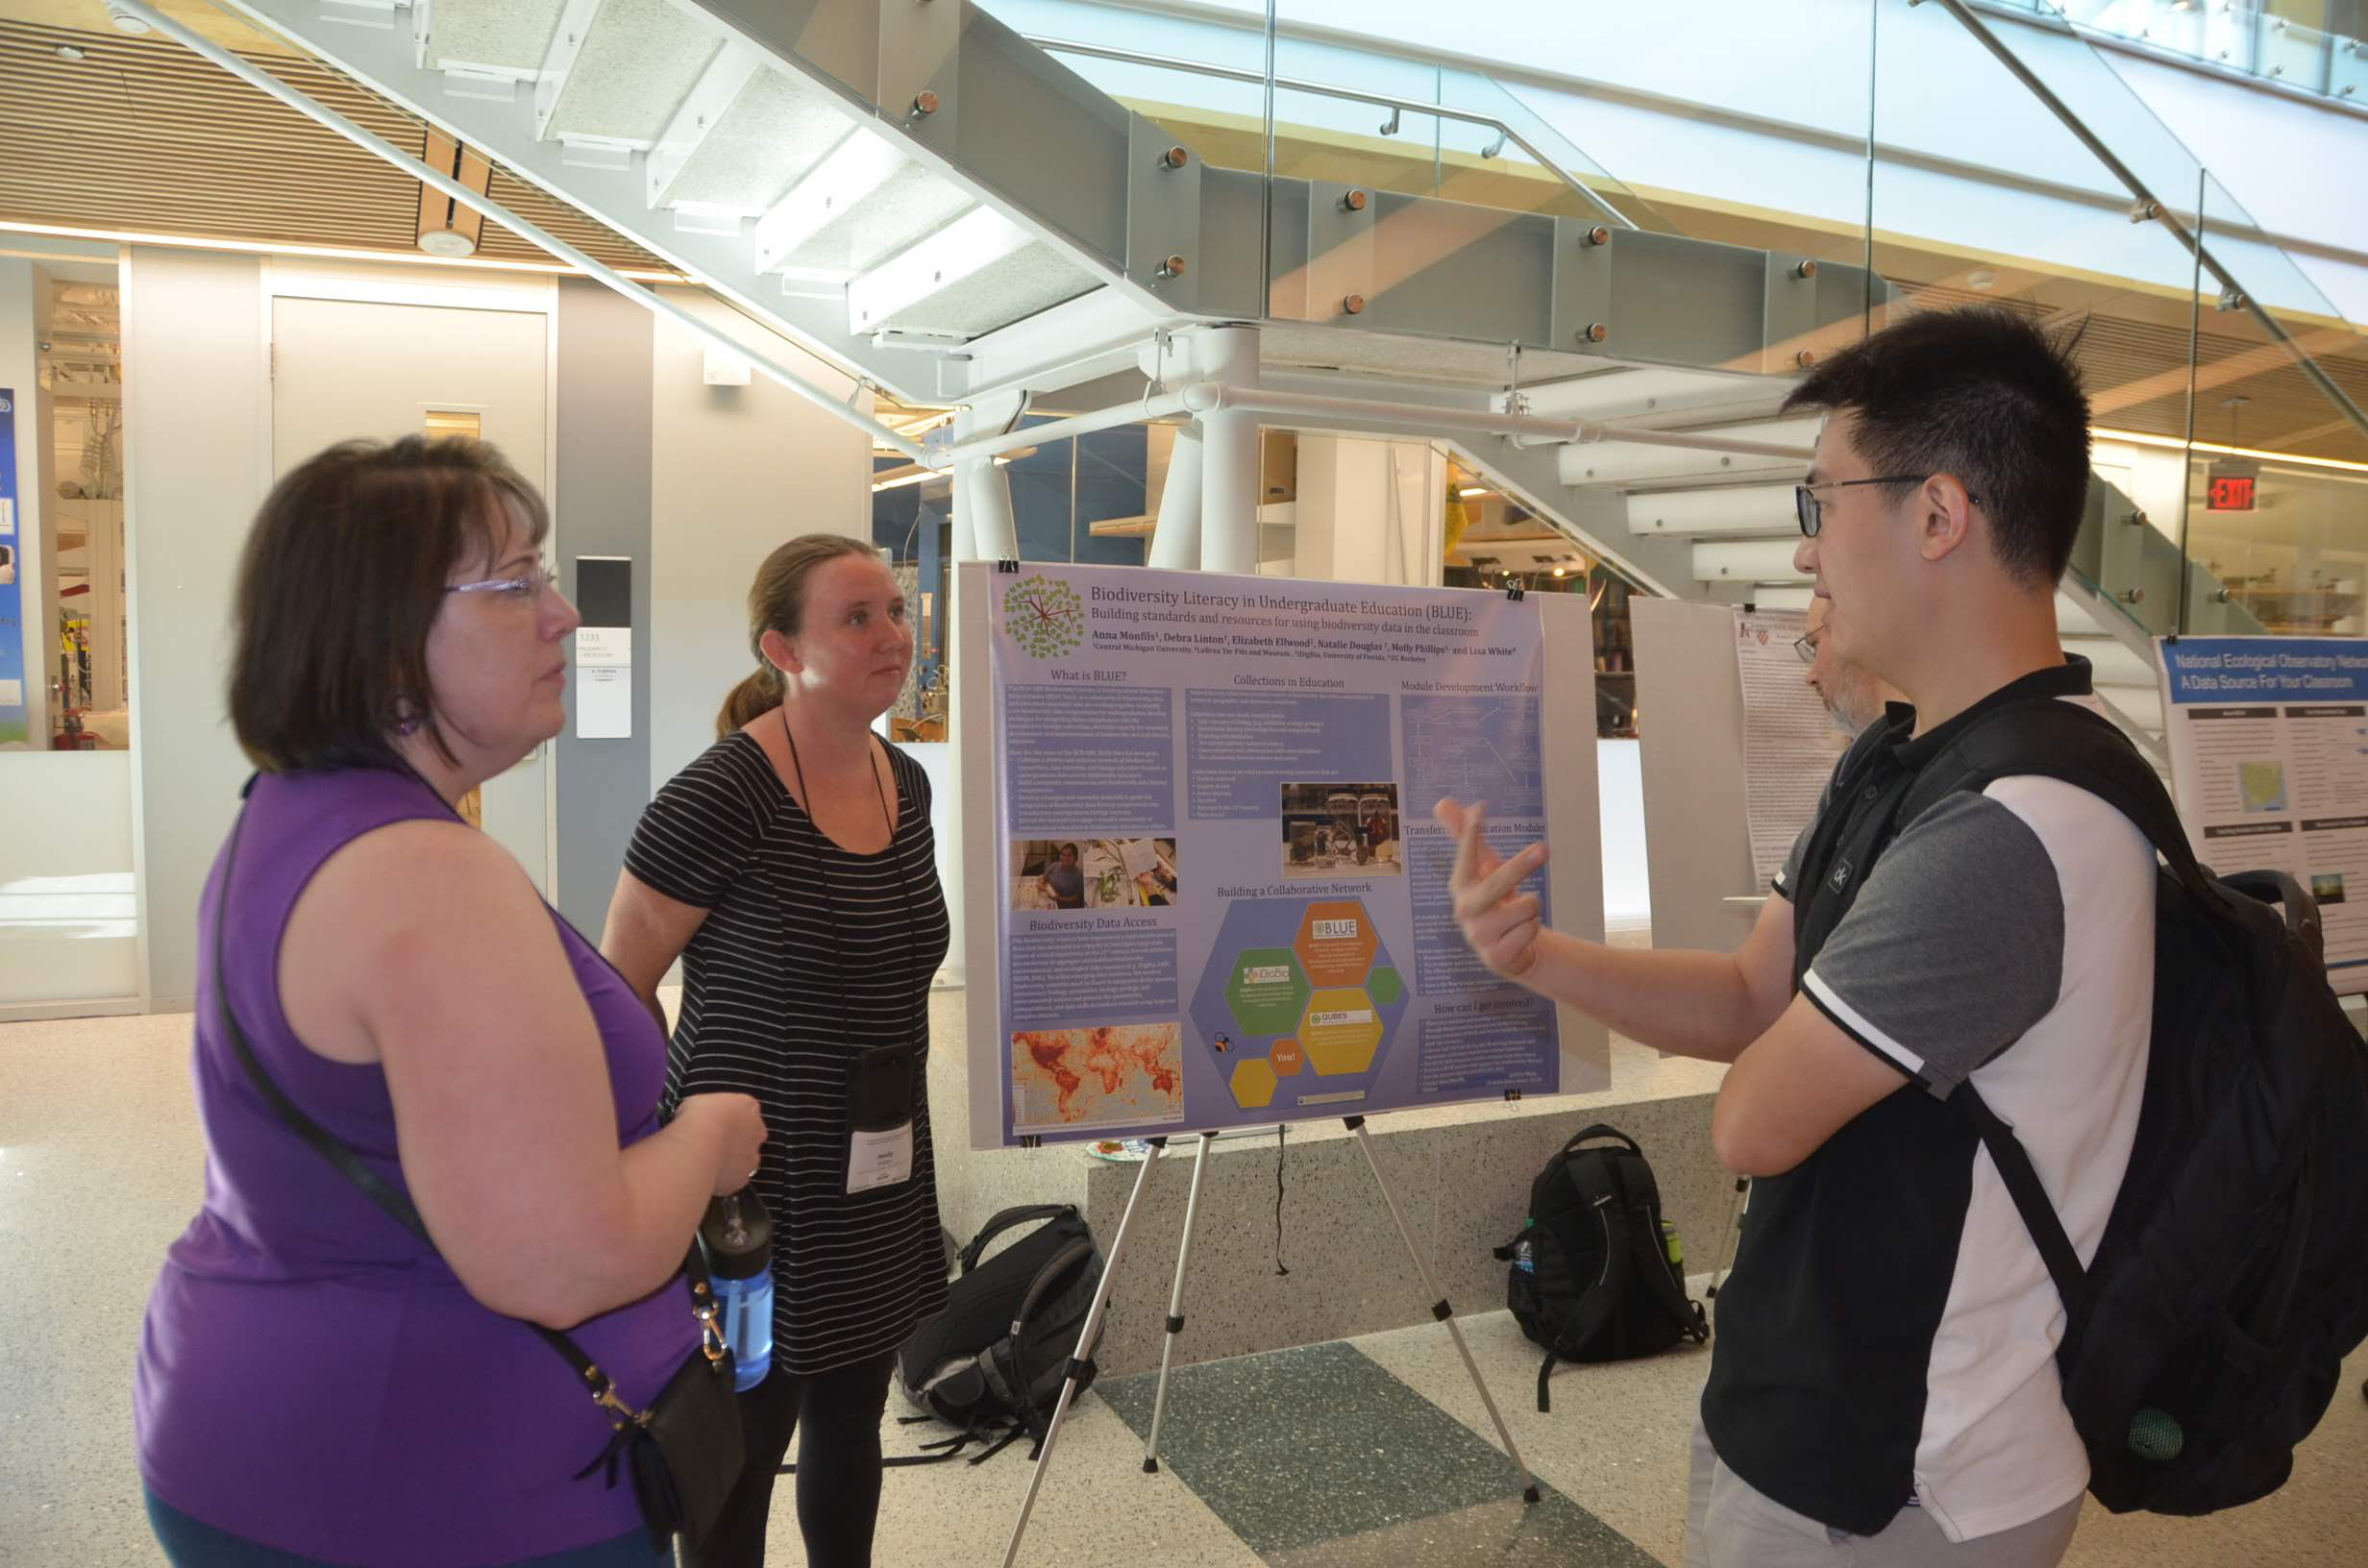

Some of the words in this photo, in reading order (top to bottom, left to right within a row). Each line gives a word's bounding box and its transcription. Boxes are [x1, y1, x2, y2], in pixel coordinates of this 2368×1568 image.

[1091, 585, 1179, 607] Biodiversity
[1183, 591, 1239, 611] Literacy
[1243, 593, 1255, 608] in
[1259, 595, 1358, 614] Undergraduate
[1361, 600, 1422, 618] Education
[1426, 604, 1472, 622] (BLUE):
[1091, 607, 1140, 623] Building
[1141, 610, 1196, 624] standards
[1198, 612, 1219, 624] and
[1221, 616, 1272, 626] resources
[1274, 615, 1291, 627] for
[1292, 618, 1320, 630] using
[1321, 619, 1379, 634] biodiversity
[1381, 623, 1402, 634] data
[1404, 624, 1414, 634] in
[1416, 624, 1431, 635] the
[1433, 625, 1479, 637] classroom
[1092, 630, 1118, 641] Anna
[1164, 633, 1192, 643] Debra
[1232, 636, 1273, 647] Elizabeth
[1318, 641, 1347, 650] Natalie
[1349, 642, 1383, 654] Douglas
[1392, 644, 1413, 654] Molly
[1452, 647, 1468, 655] and
[1469, 647, 1486, 655] Lisa
[1122, 644, 1154, 654] Michigan
[1156, 646, 1193, 655] University,
[1248, 649, 1262, 657] and
[1323, 651, 1354, 662] University
[2175, 654, 2222, 670] National
[2224, 653, 2277, 673] Ecological
[1050, 669, 1079, 681] What
[1082, 671, 1091, 681] is
[1094, 671, 1127, 682] BLUE?
[1233, 674, 1286, 688] Collections
[1288, 676, 1297, 688] in
[1299, 677, 1345, 689] Education
[2190, 676, 2219, 691] Data
[2219, 675, 2258, 691] Source
[1400, 680, 1434, 693] Module
[1436, 682, 1493, 694] Development
[1495, 683, 1538, 694] Workflow
[1217, 887, 1258, 899] Building
[1267, 884, 1329, 896] Collaborative
[1331, 882, 1372, 894] Network
[1029, 919, 1094, 932] Biodiversity
[1097, 918, 1121, 929] Data
[1123, 917, 1157, 928] Access
[1324, 920, 1356, 935] BLUE
[1434, 1003, 1455, 1015] How
[1457, 1004, 1472, 1014] can
[1275, 1053, 1295, 1063] You!
